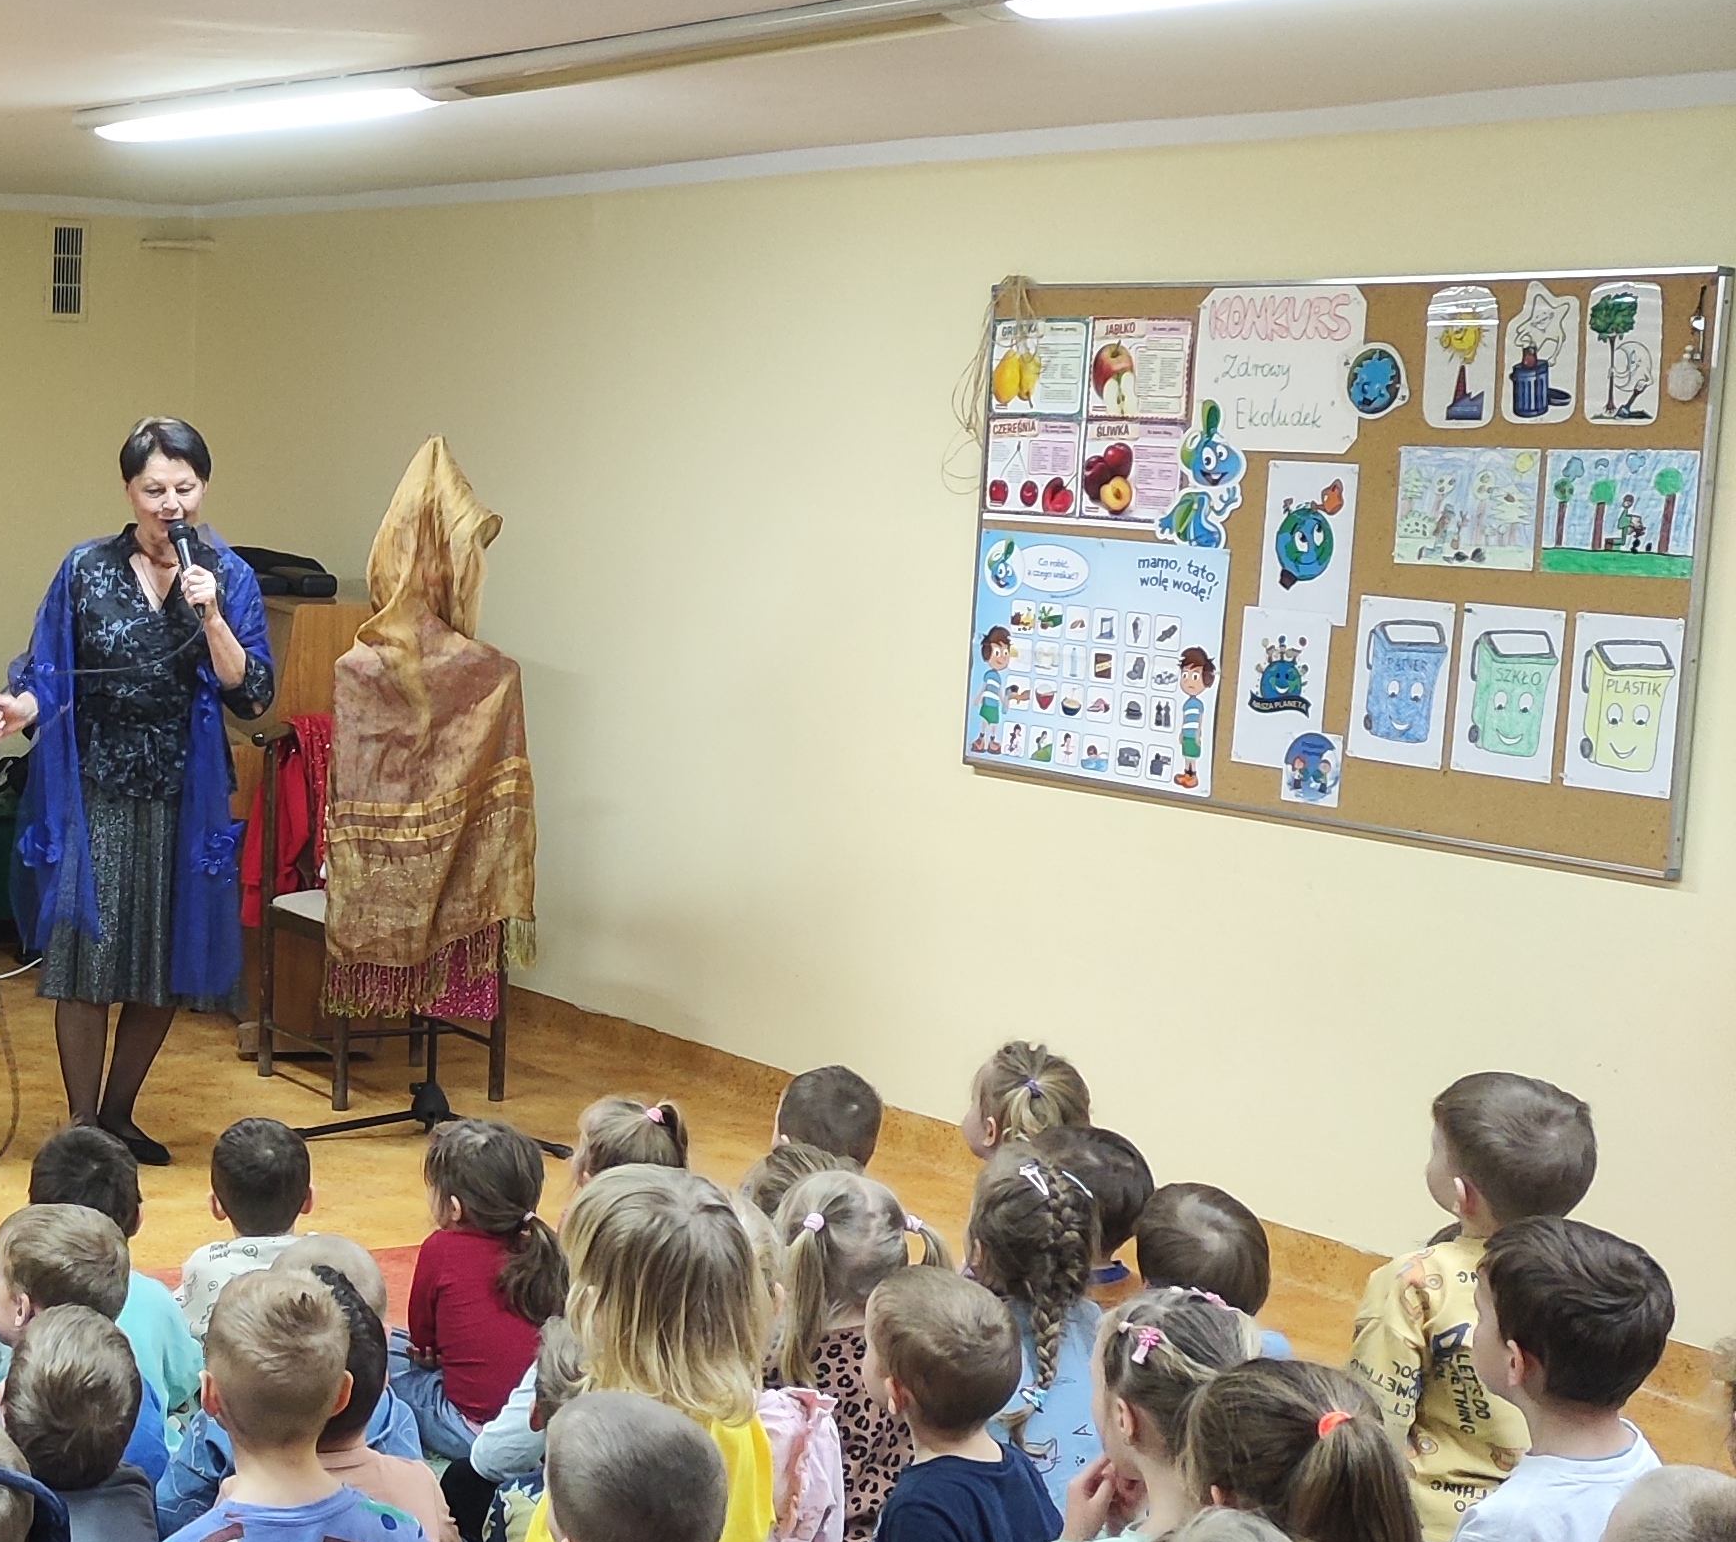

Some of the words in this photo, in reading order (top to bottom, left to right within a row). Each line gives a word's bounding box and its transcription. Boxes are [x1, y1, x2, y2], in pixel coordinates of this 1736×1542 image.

[1208, 293, 1352, 341] KONKURS
[993, 420, 1037, 435] CZEREŚNIA
[1096, 424, 1130, 438] ŚLIWKA
[1137, 557, 1182, 573] mamo,
[1186, 559, 1220, 587] tato,
[1139, 569, 1169, 592] wolę
[1172, 579, 1213, 603] wodę!
[1495, 667, 1542, 686] SZKŁO
[1606, 679, 1663, 698] PLASTIK
